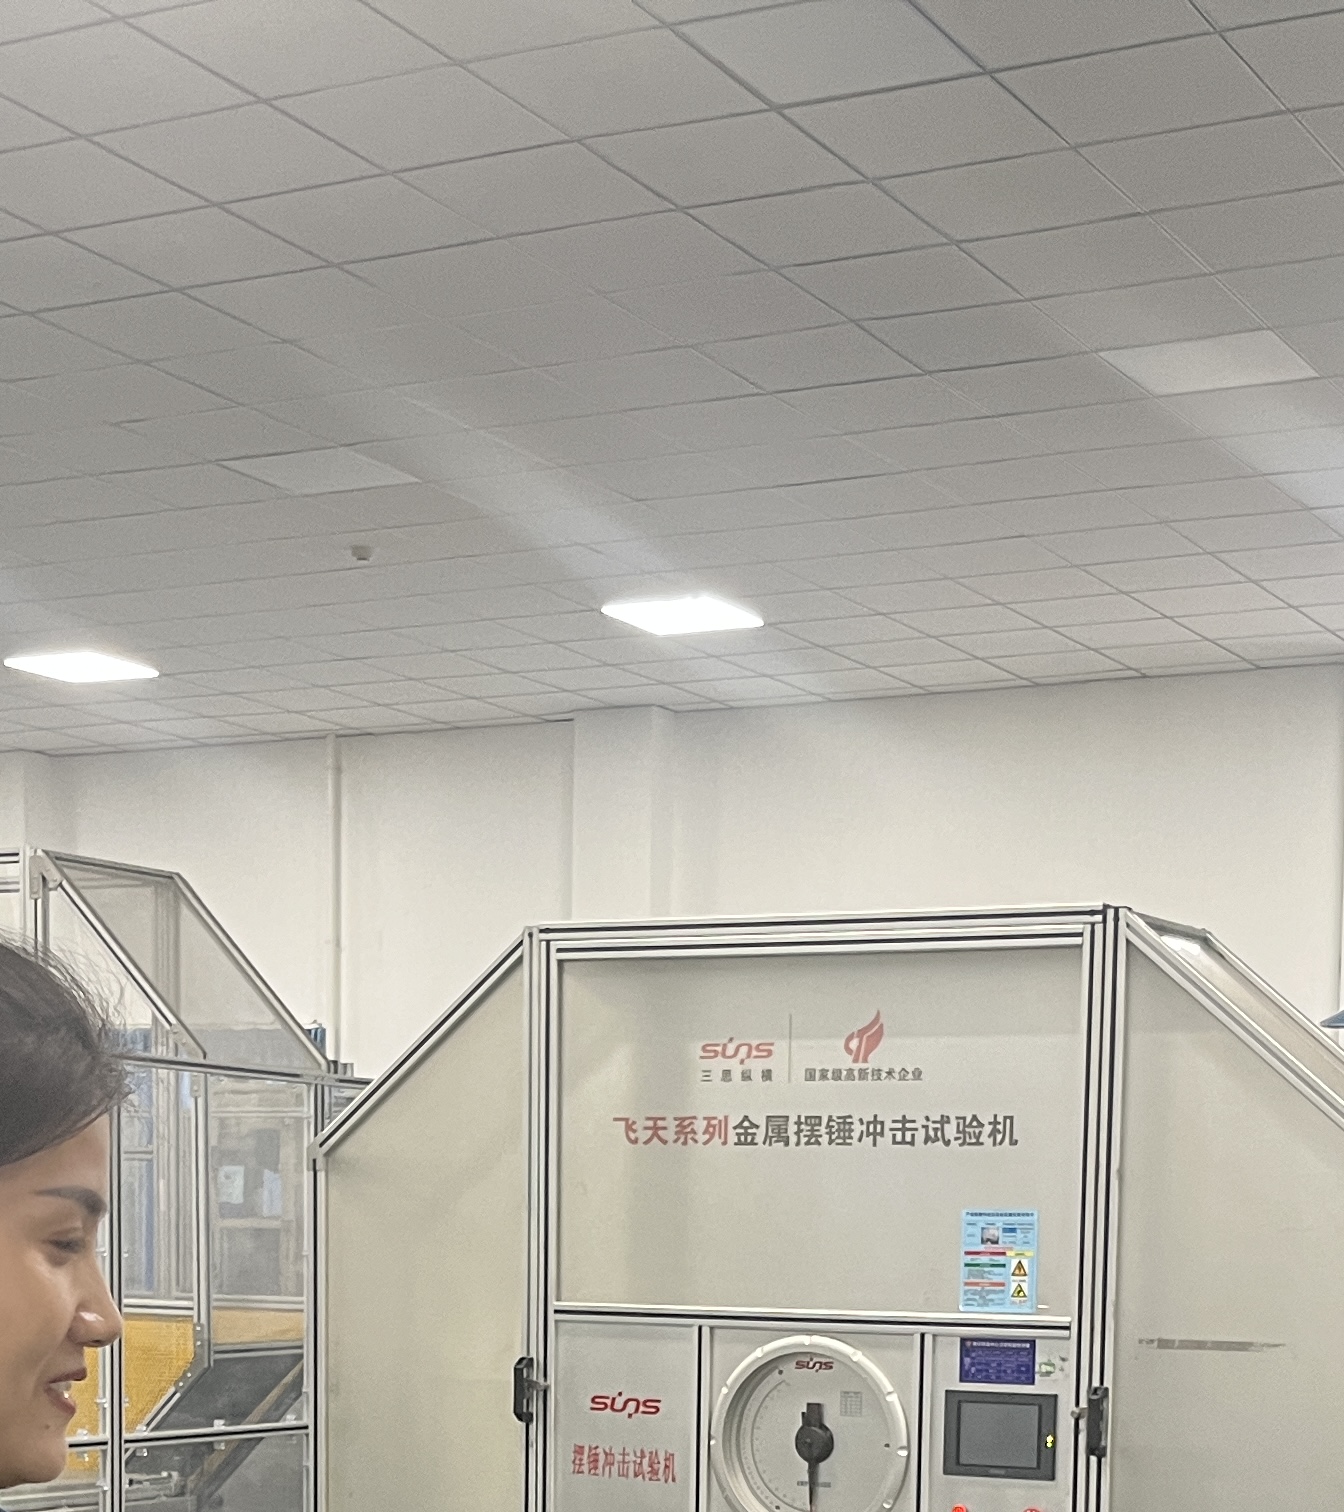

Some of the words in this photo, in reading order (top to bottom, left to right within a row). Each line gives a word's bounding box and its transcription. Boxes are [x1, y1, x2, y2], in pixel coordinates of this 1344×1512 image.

[701, 1069, 772, 1082] 三思纵横
[804, 1067, 923, 1082] 国家级高新技术企业
[612, 1113, 1019, 1149] 飞天系列金属摆锤冲击试验机
[571, 1442, 677, 1484] 摆锤冲击试验机
